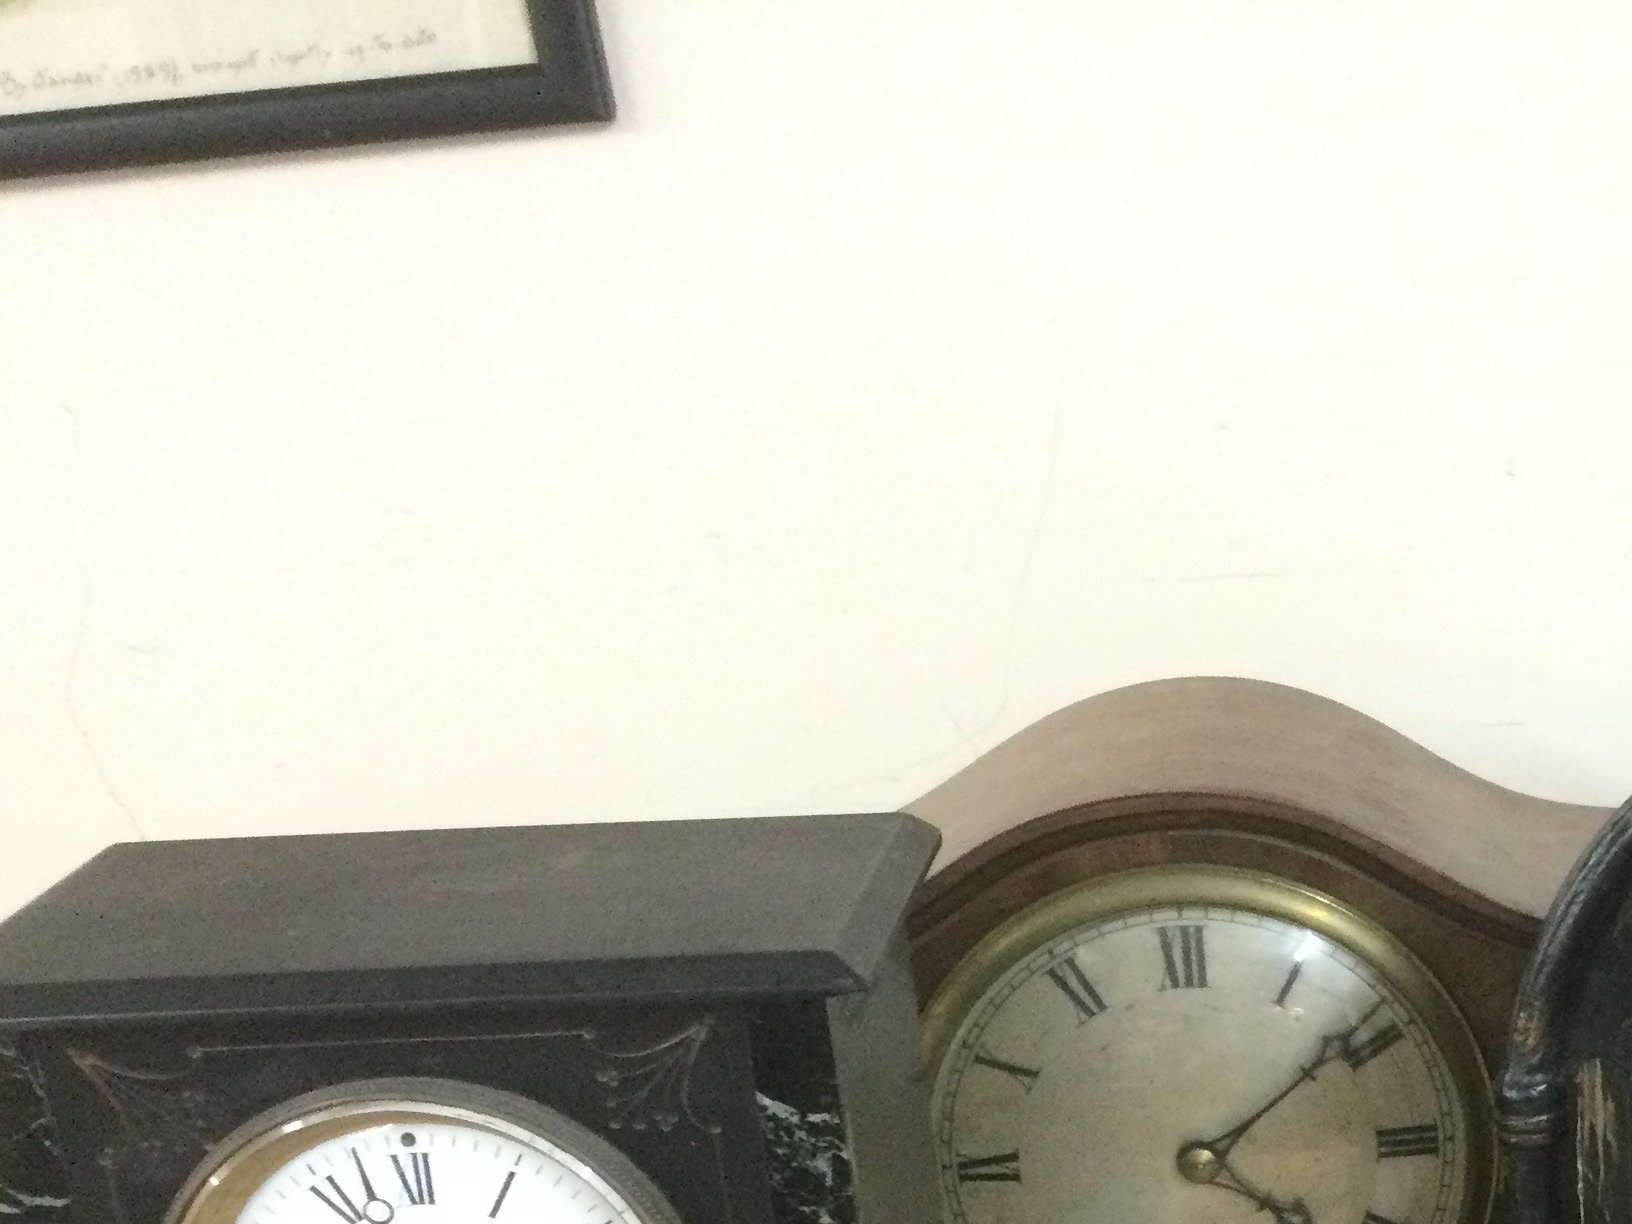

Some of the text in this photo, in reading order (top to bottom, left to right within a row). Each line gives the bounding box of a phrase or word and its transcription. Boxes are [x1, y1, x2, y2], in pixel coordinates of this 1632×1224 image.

[1374, 1120, 1441, 1159] III
[390, 1152, 437, 1206] XII
[488, 1170, 518, 1219] I
